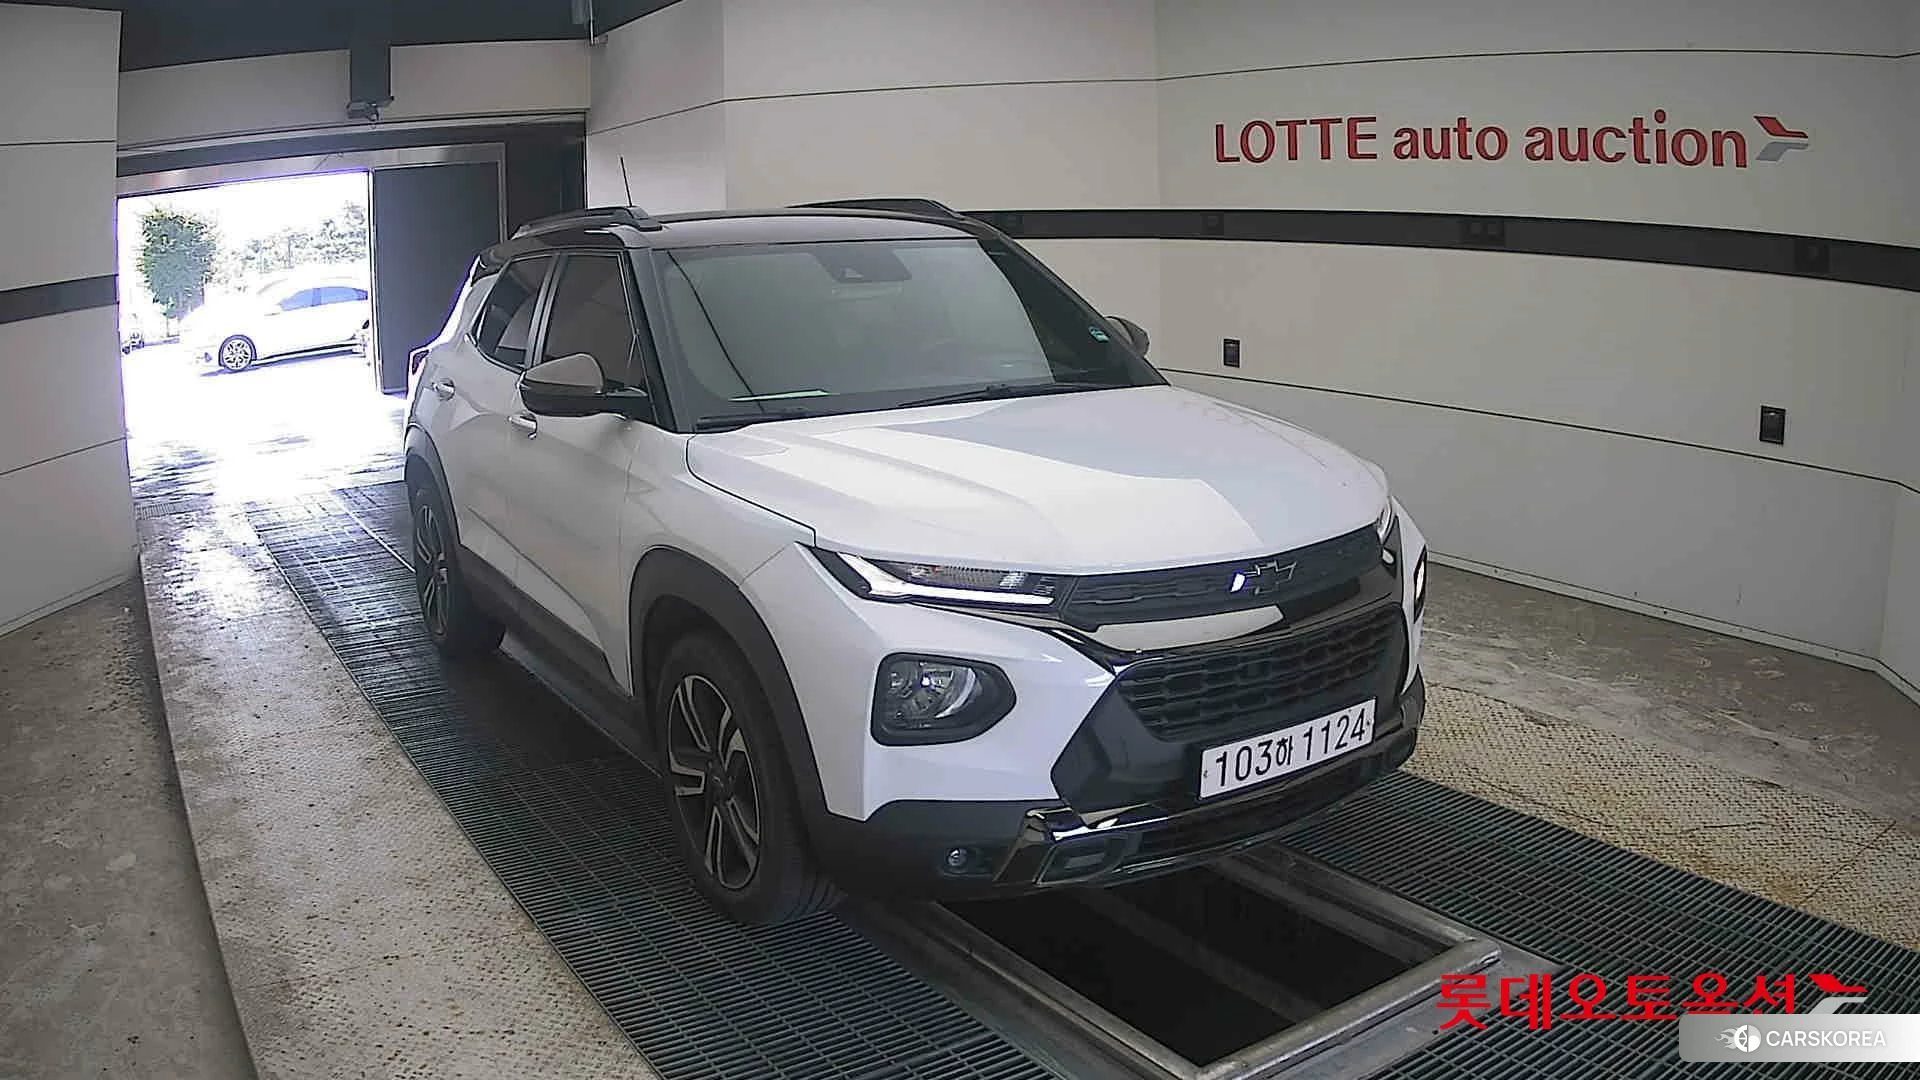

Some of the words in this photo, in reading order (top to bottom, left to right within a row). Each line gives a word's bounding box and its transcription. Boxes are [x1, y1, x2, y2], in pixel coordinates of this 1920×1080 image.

[1215, 117, 1378, 163] LOTTE
[1393, 117, 1509, 161] auto
[1524, 109, 1748, 168] auction
[1215, 735, 1293, 787] 103하
[1303, 708, 1366, 761] 1124
